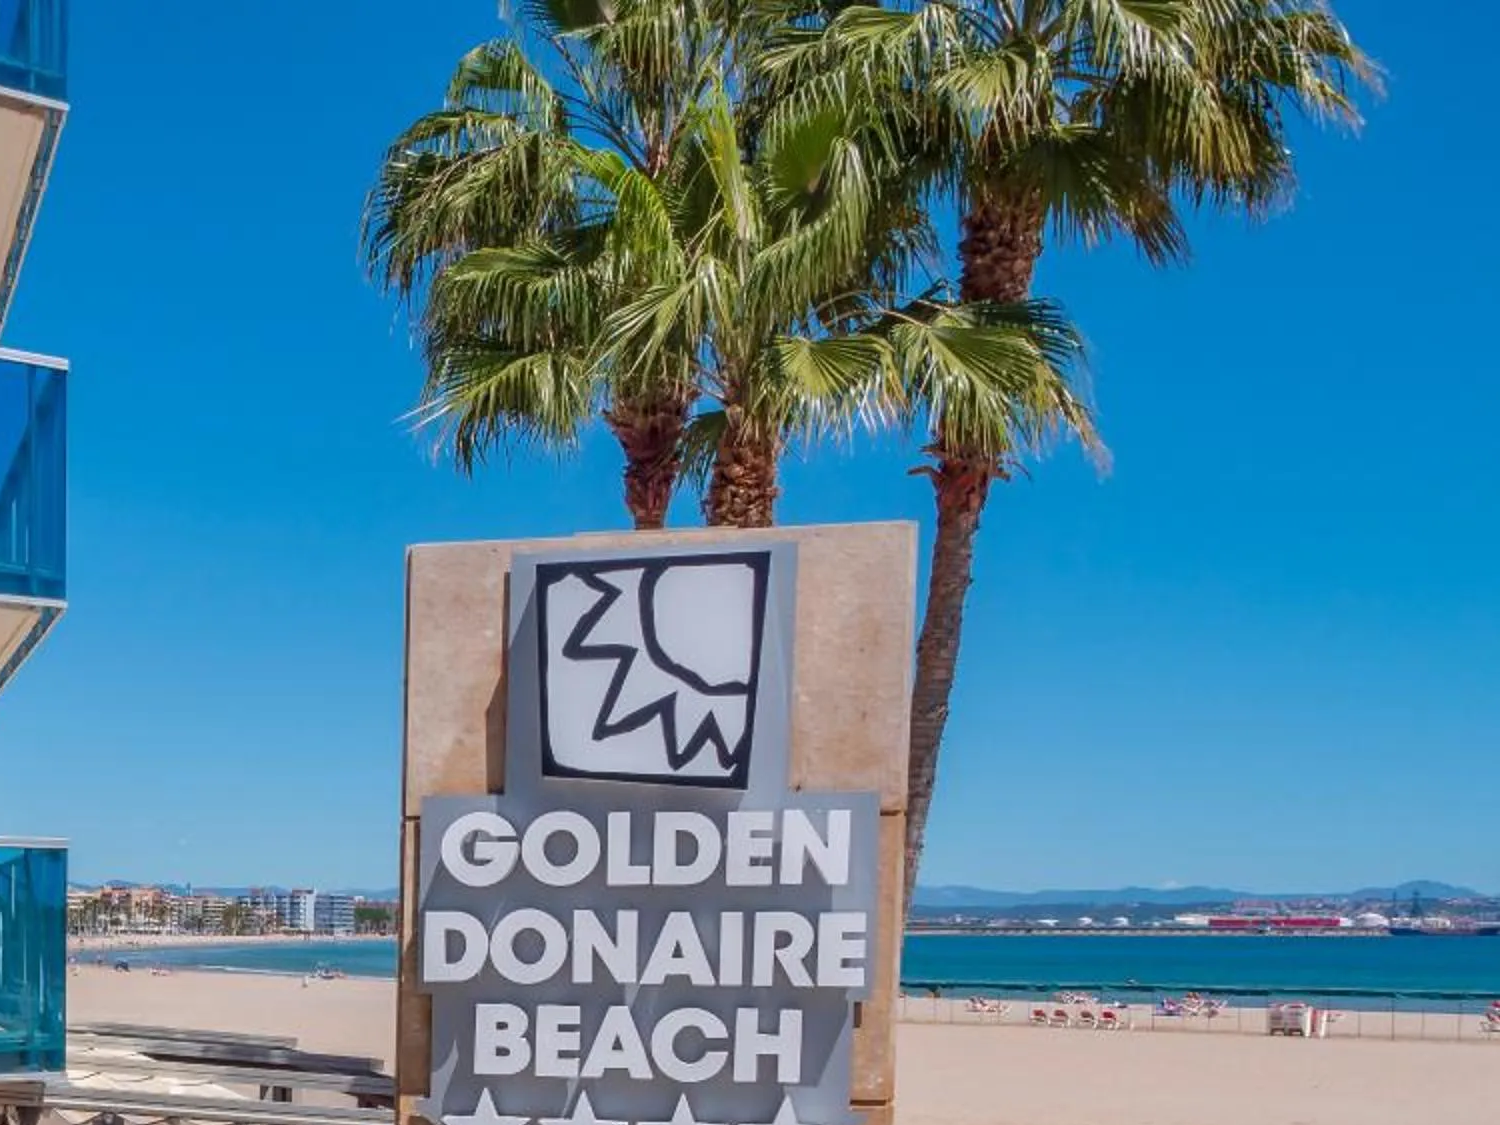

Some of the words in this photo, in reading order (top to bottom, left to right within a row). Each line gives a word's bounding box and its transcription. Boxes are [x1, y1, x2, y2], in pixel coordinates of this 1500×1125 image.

[440, 809, 852, 888] GOLDEN
[423, 910, 867, 988] DONAIRE
[473, 1003, 803, 1083] BEACH
